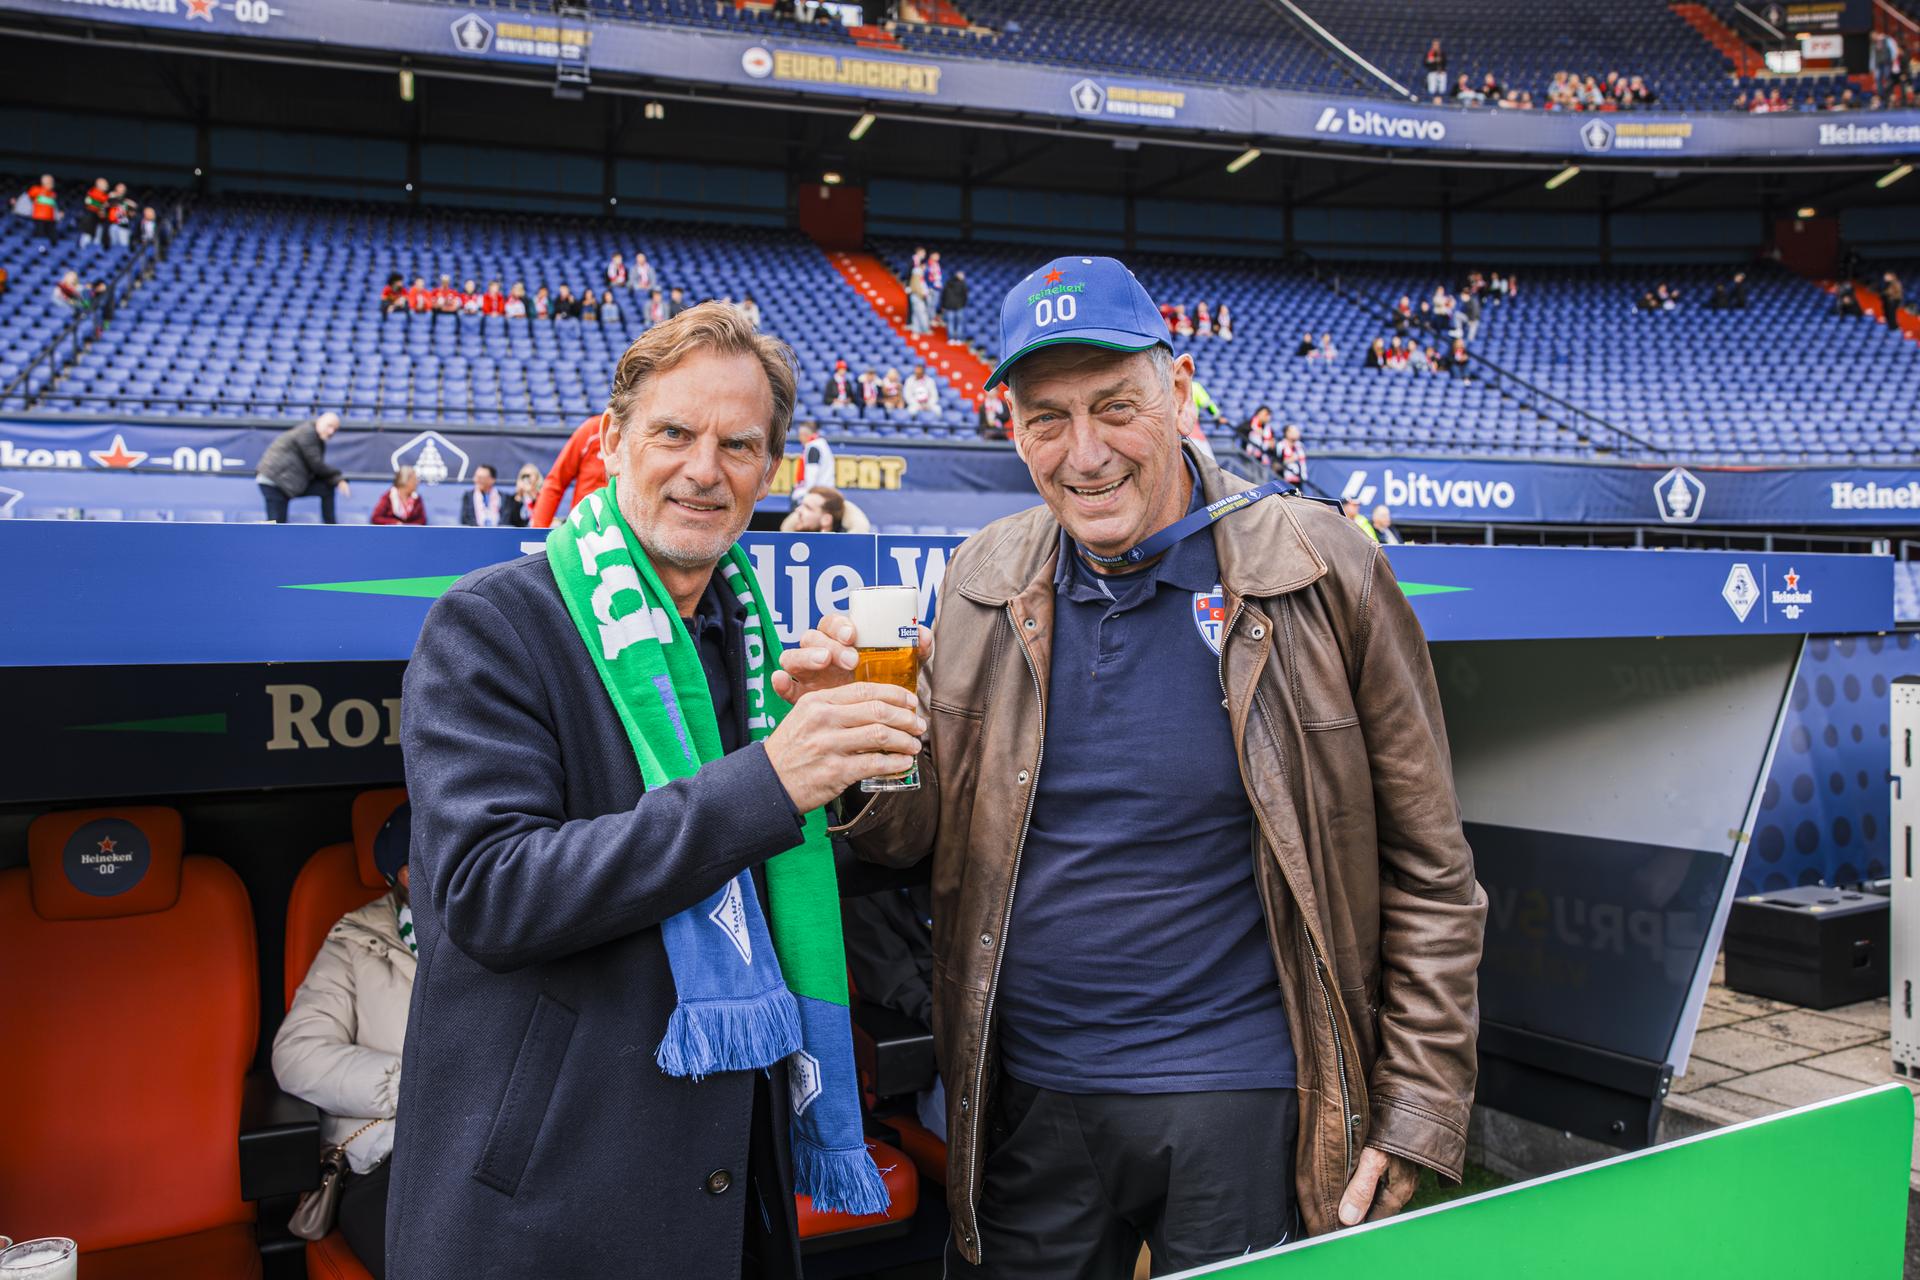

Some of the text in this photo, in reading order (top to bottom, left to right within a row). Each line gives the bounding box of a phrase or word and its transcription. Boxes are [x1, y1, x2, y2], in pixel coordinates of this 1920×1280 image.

[774, 50, 942, 95] EUROJACKPOT
[1347, 107, 1446, 140] bitvavo
[1035, 294, 1077, 328] 0.0
[1384, 469, 1515, 508] bitvavo
[1199, 600, 1206, 609] S
[1213, 610, 1220, 618] C
[1205, 623, 1219, 640] T
[81, 852, 132, 864] Heineken
